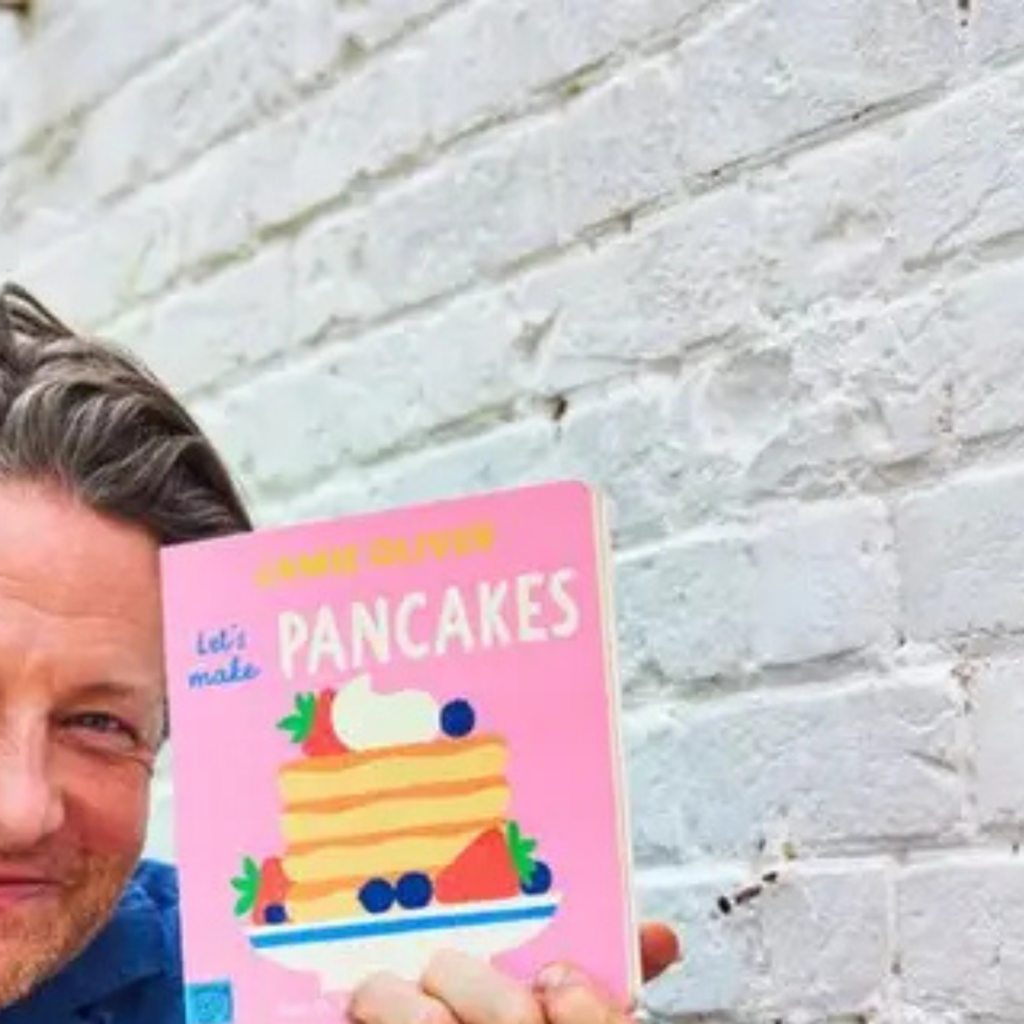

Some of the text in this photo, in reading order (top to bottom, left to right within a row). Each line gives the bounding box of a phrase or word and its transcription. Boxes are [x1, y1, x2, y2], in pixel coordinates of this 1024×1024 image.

[277, 567, 580, 680] PANCAKES
[195, 624, 246, 657] Let's
[188, 659, 260, 689] make
